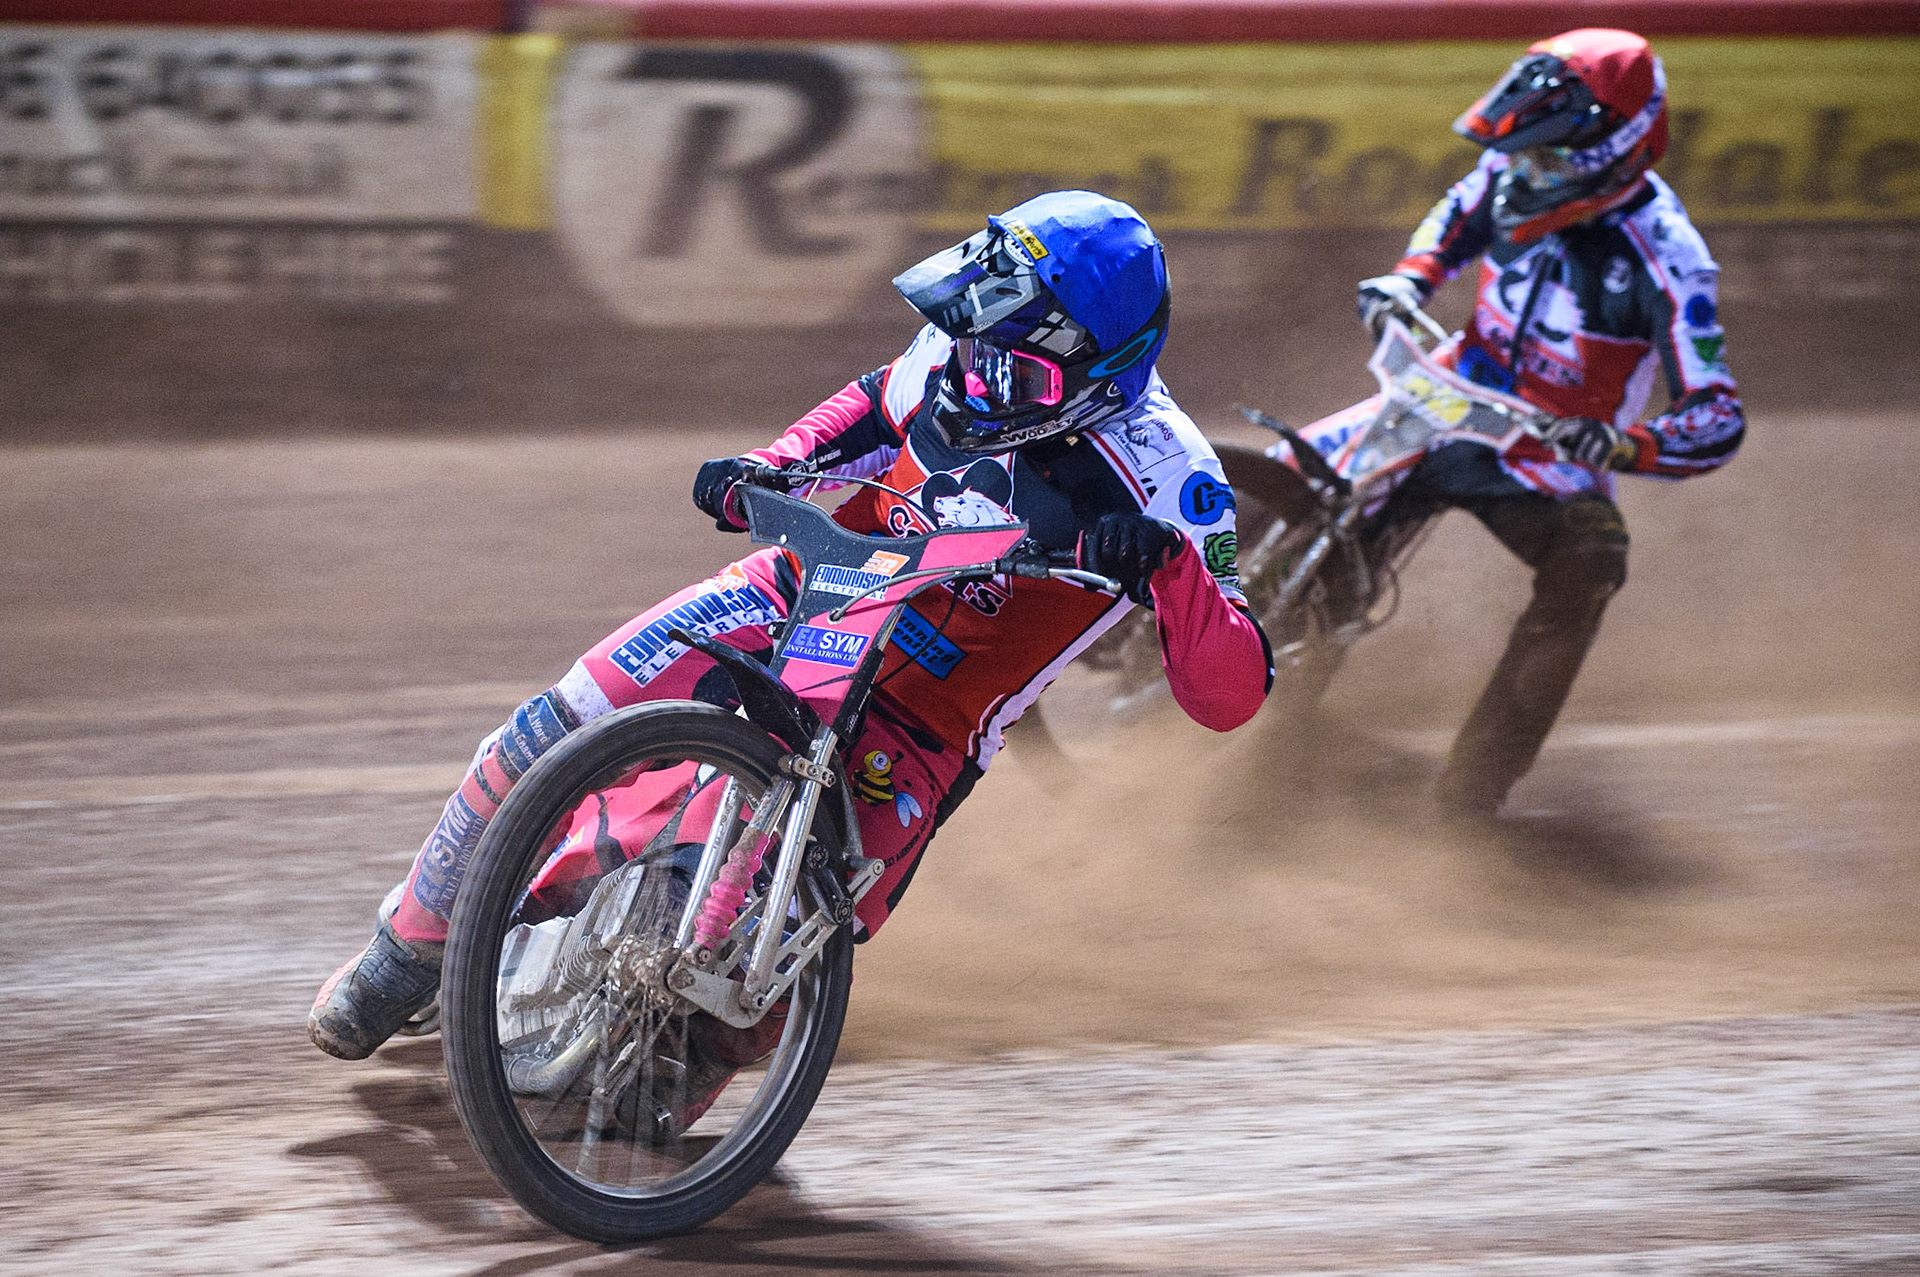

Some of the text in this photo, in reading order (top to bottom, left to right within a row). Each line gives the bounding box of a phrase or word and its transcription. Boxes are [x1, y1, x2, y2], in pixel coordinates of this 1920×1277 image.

[810, 583, 886, 600] ELECTRIAL
[635, 611, 782, 687] ELETRICA
[786, 644, 859, 662] INSTALLATIONS LTD
[529, 717, 551, 744] Ward
